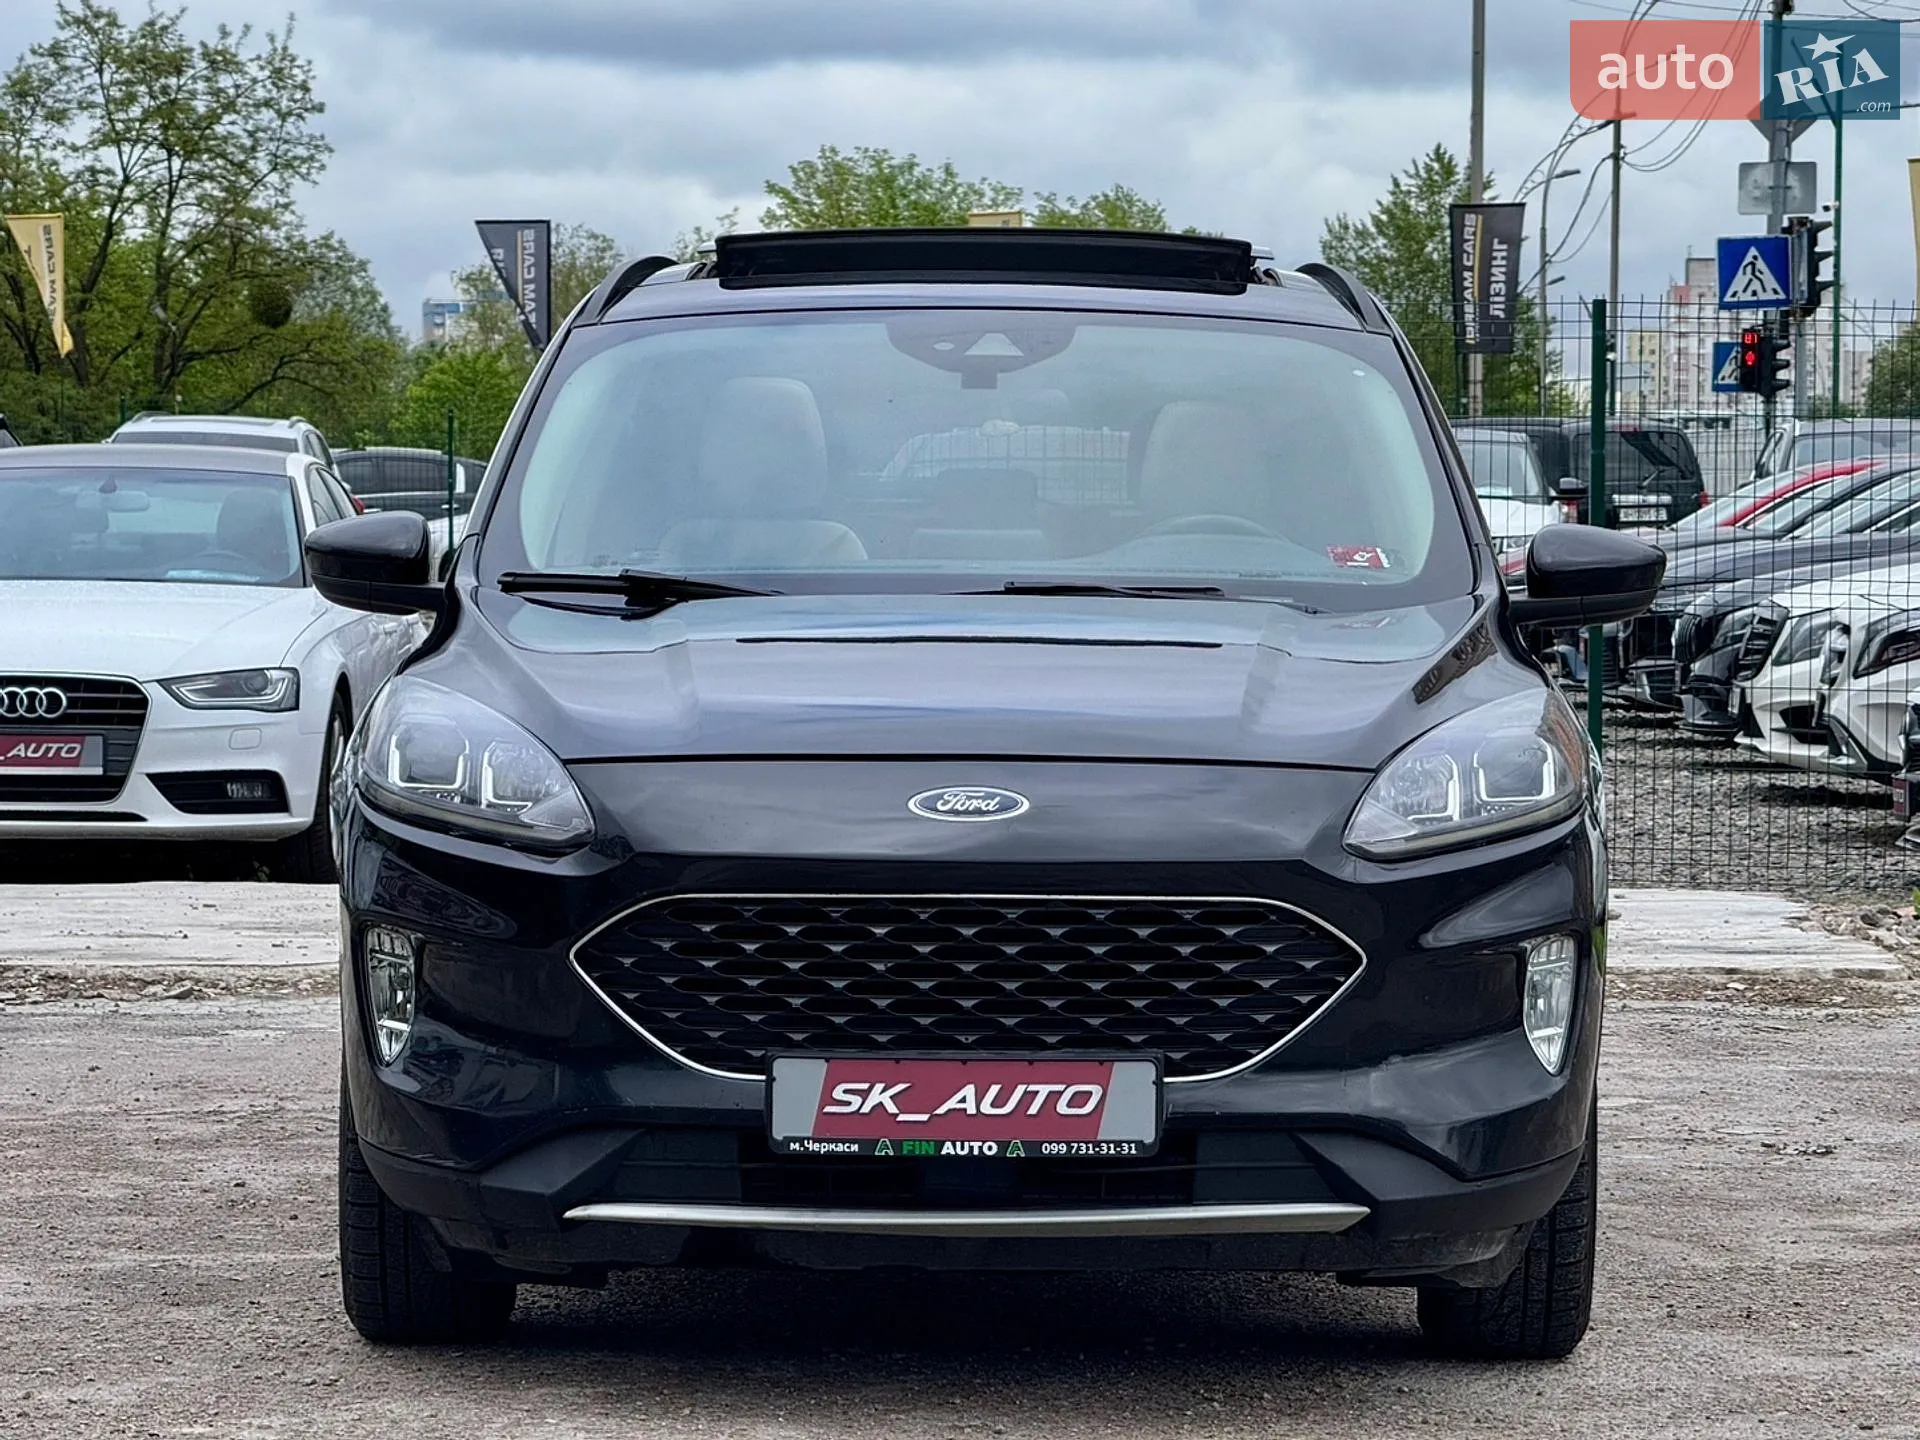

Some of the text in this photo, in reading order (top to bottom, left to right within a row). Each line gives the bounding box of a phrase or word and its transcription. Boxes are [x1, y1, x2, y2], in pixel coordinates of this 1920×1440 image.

[1462, 213, 1476, 266] CARS
[936, 791, 1001, 811] Ford
[822, 1082, 1103, 1122] SK_AUTO
[789, 1139, 859, 1154] м.Черкаси
[902, 1140, 936, 1155] FIN
[940, 1141, 999, 1156] AUTO
[1041, 1142, 1070, 1155] 099
[1071, 1142, 1137, 1155] 731-31-31
